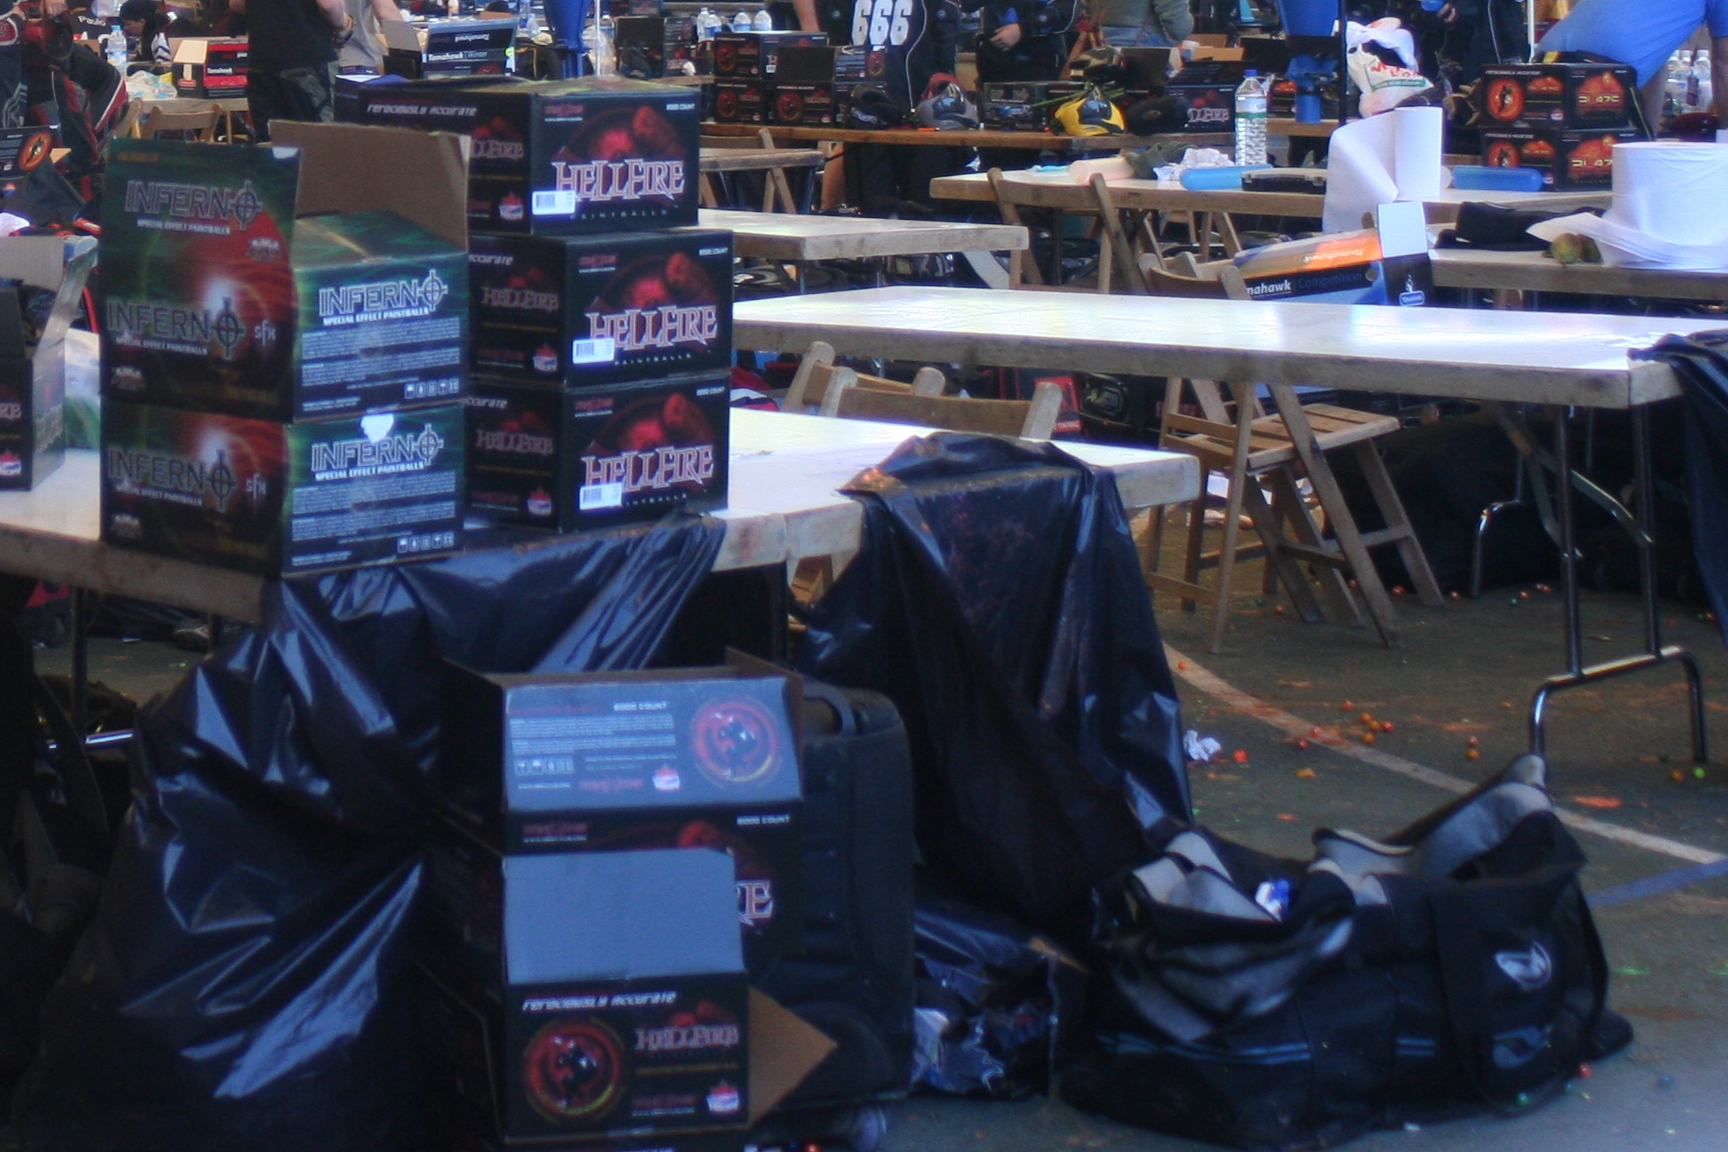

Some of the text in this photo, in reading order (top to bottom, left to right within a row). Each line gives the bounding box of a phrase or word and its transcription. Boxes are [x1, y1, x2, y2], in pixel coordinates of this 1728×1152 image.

[428, 51, 463, 61] Tomahawk
[124, 178, 263, 230] INFERNO
[551, 158, 685, 201] HELLFIRE
[319, 268, 449, 317] INFERNO
[1246, 271, 1363, 296] mahawk Competition
[107, 296, 247, 361] INFERNO
[584, 305, 718, 351] HELLFIRE
[311, 423, 445, 472] INFERNO
[581, 444, 714, 494] HELLFIRE
[108, 446, 240, 513] INFERNO
[625, 492, 687, 507] INTBALLS
